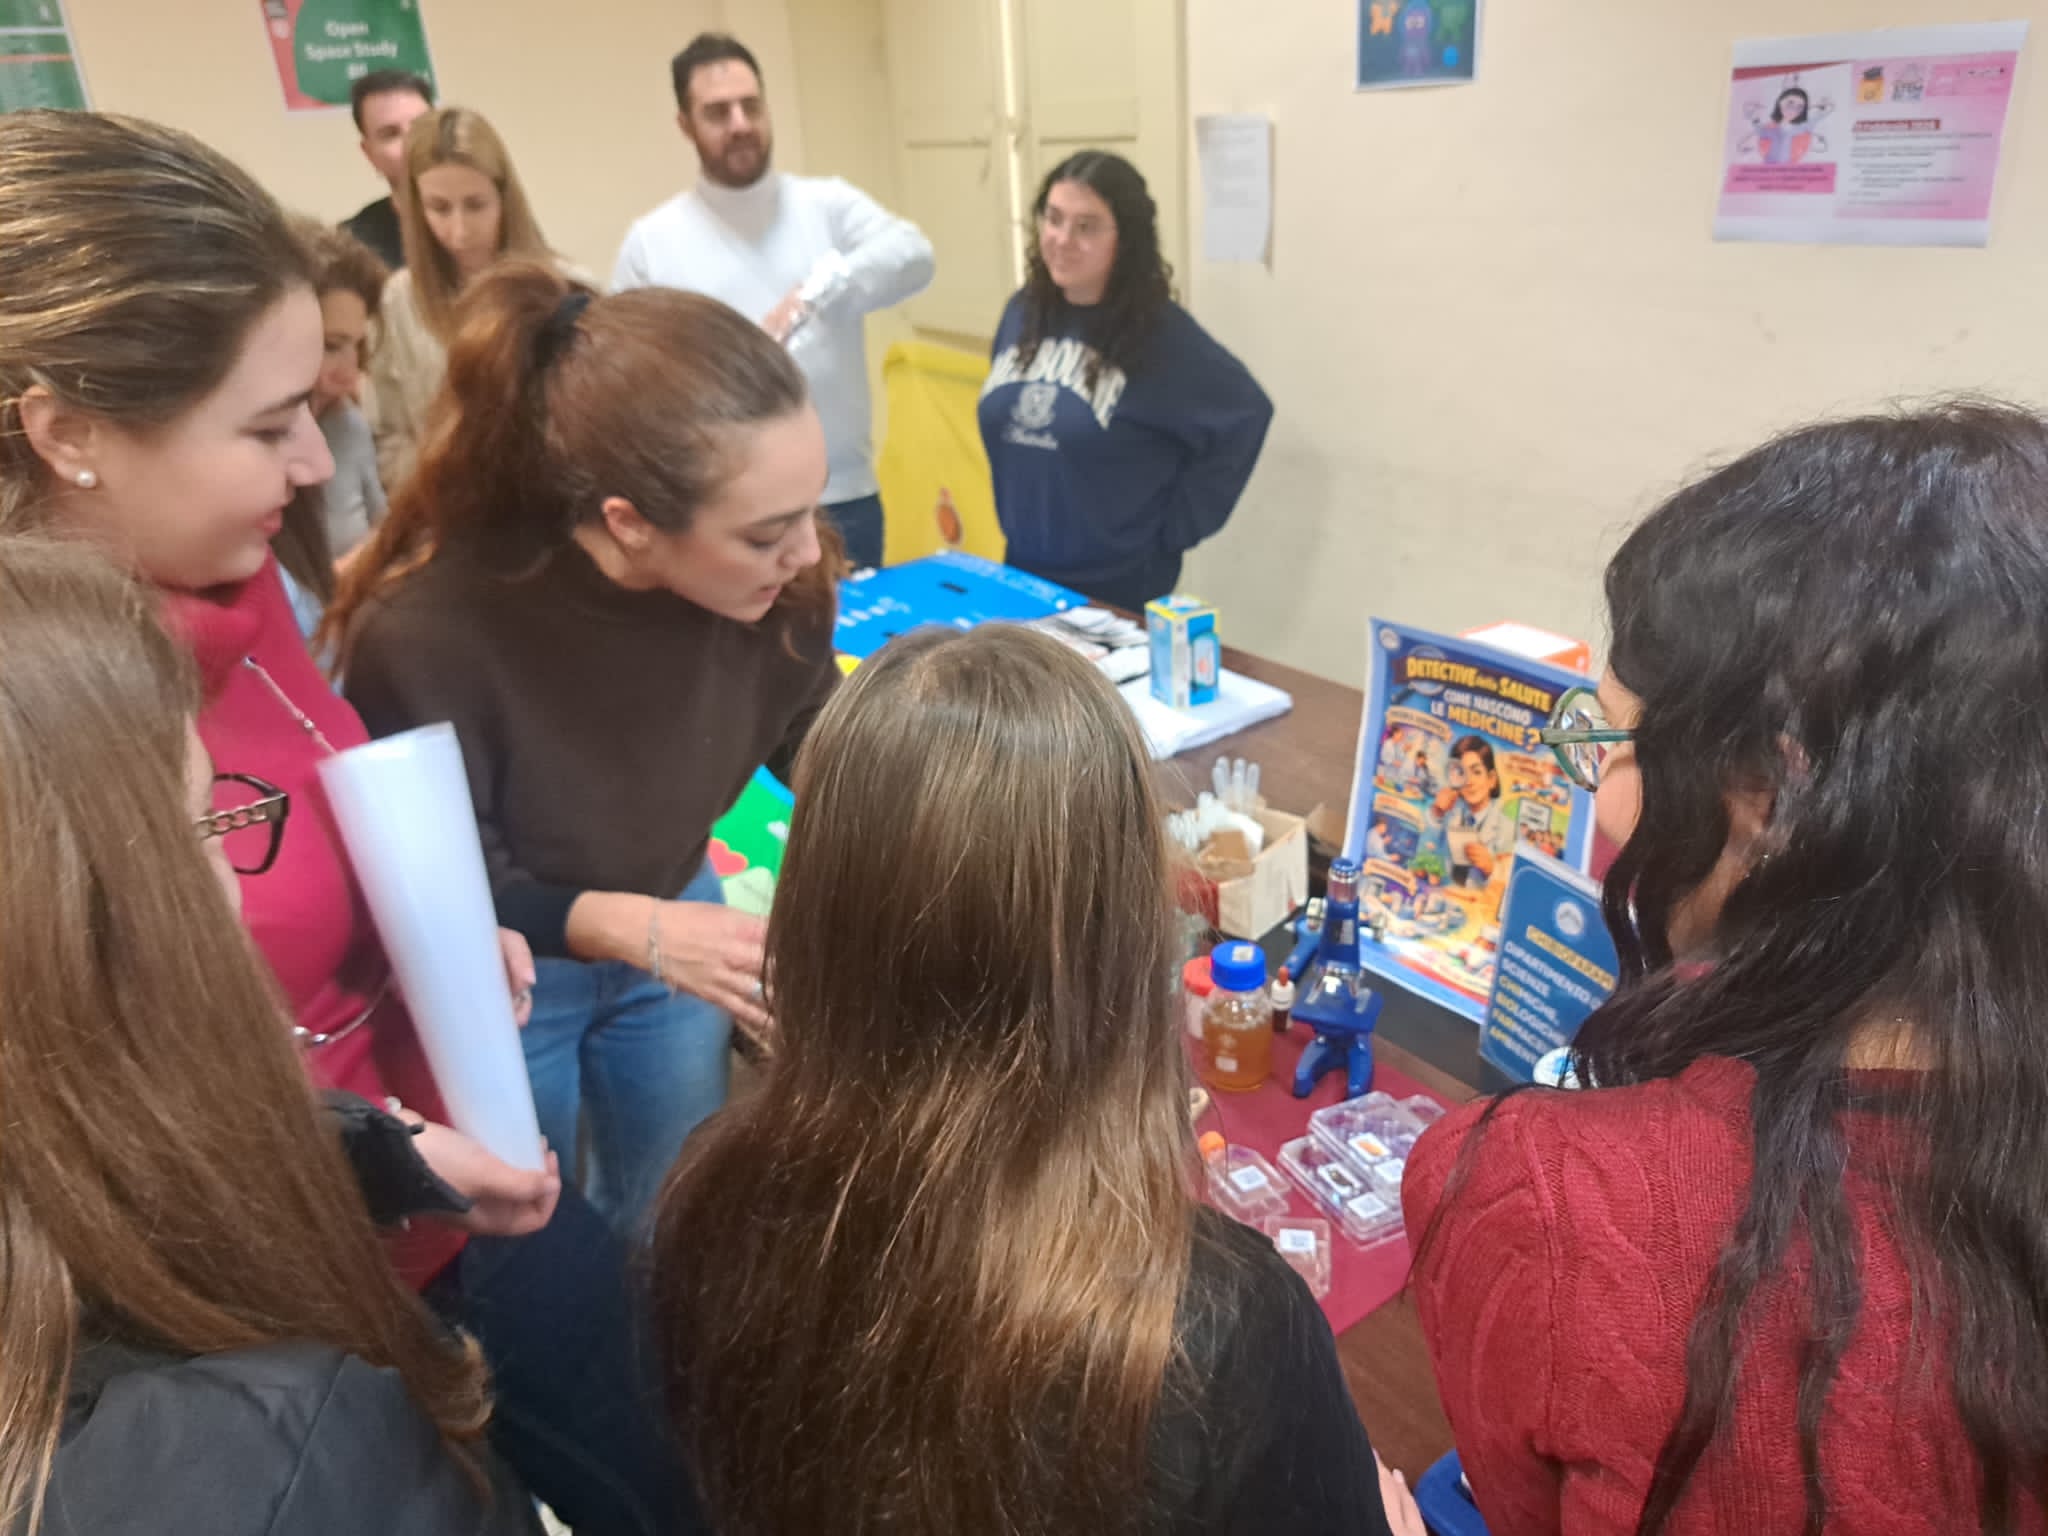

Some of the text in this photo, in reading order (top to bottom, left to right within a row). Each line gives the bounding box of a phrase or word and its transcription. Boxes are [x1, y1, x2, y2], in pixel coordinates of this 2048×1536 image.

[325, 20, 369, 39] Open
[305, 40, 398, 62] Space Study
[979, 336, 1127, 431] MEBOUNE
[1407, 656, 1477, 688] DETECTIVE
[1499, 676, 1552, 712] SALUTE
[1431, 700, 1445, 717] LE
[1444, 688, 1471, 707] COME
[1473, 695, 1532, 726] NASCONO
[1502, 957, 1551, 998] SCIENZE
[1504, 940, 1591, 1004] DIPARTIMENTO
